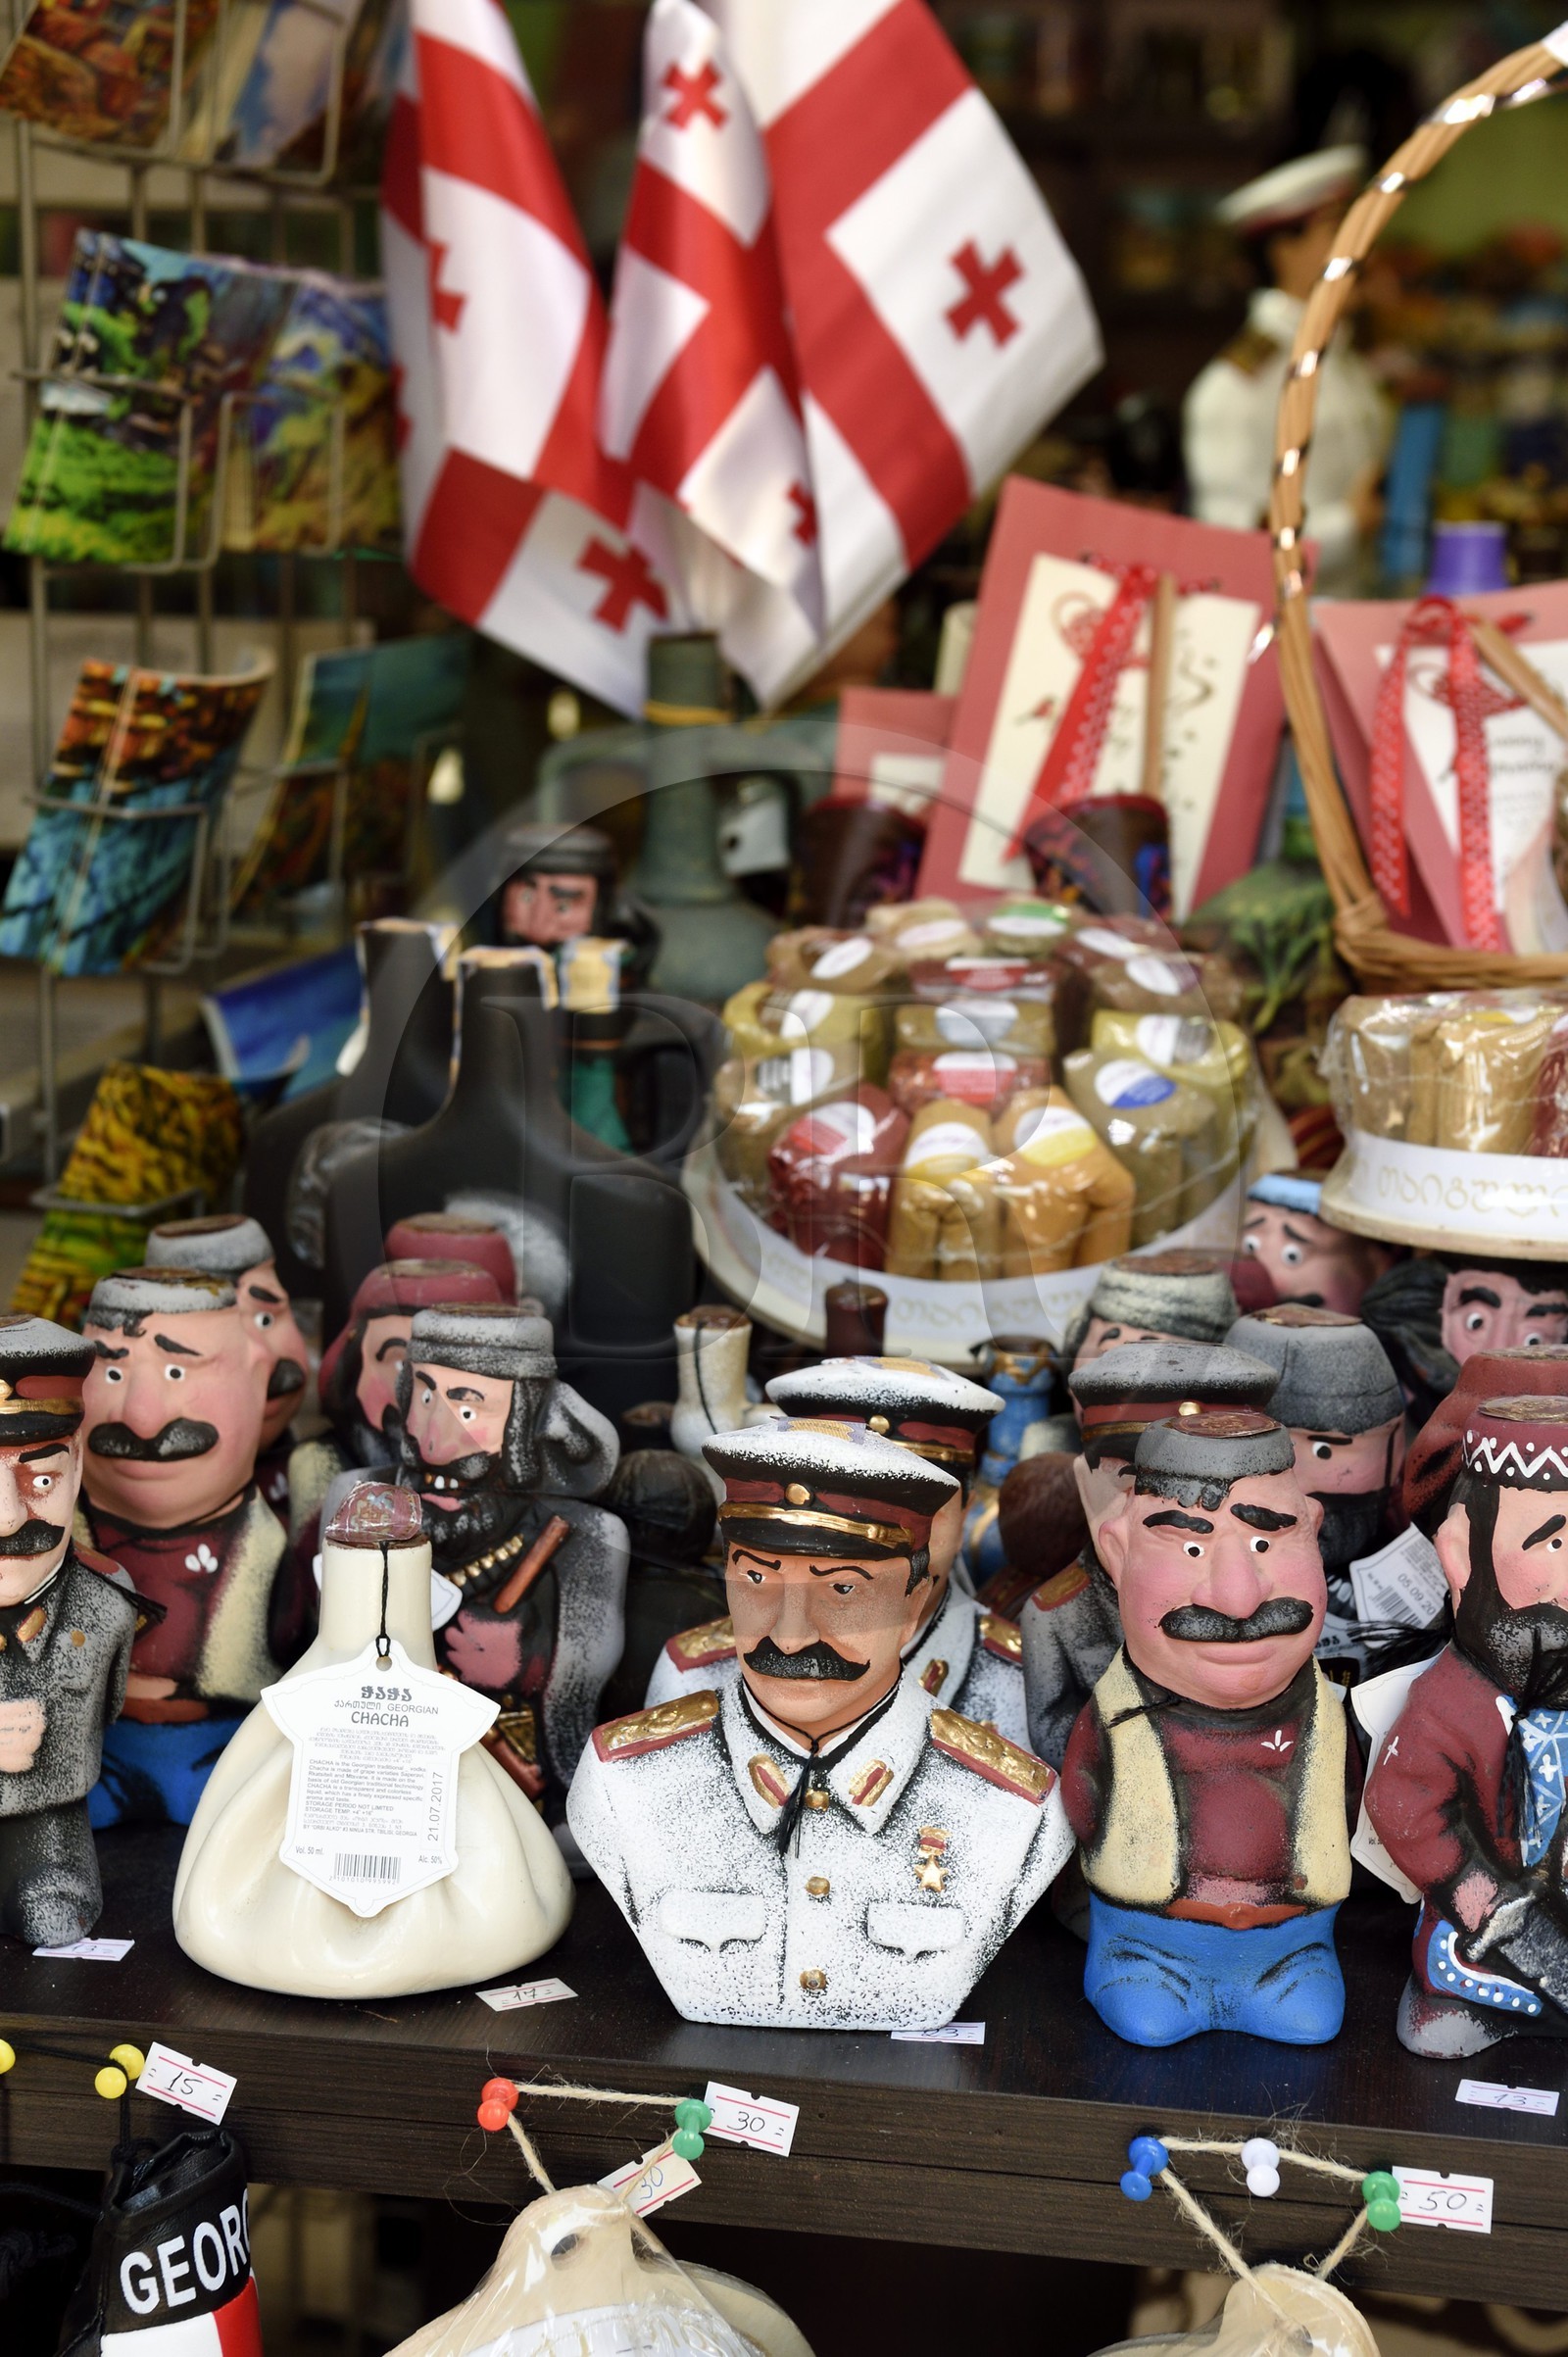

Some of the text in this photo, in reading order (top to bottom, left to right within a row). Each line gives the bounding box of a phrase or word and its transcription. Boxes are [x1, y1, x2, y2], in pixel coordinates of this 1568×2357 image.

[387, 1702, 439, 1715] GEORGIAN
[351, 1711, 410, 1727] CHACHA
[395, 1783, 423, 1792] technology
[427, 1771, 443, 1841] 21.07.2017
[295, 1845, 306, 1854] Vol.
[417, 1854, 442, 1864] Alc. 50%
[726, 2110, 765, 2133] 30
[1418, 2190, 1467, 2211] 50
[120, 2188, 251, 2315] GEOR
